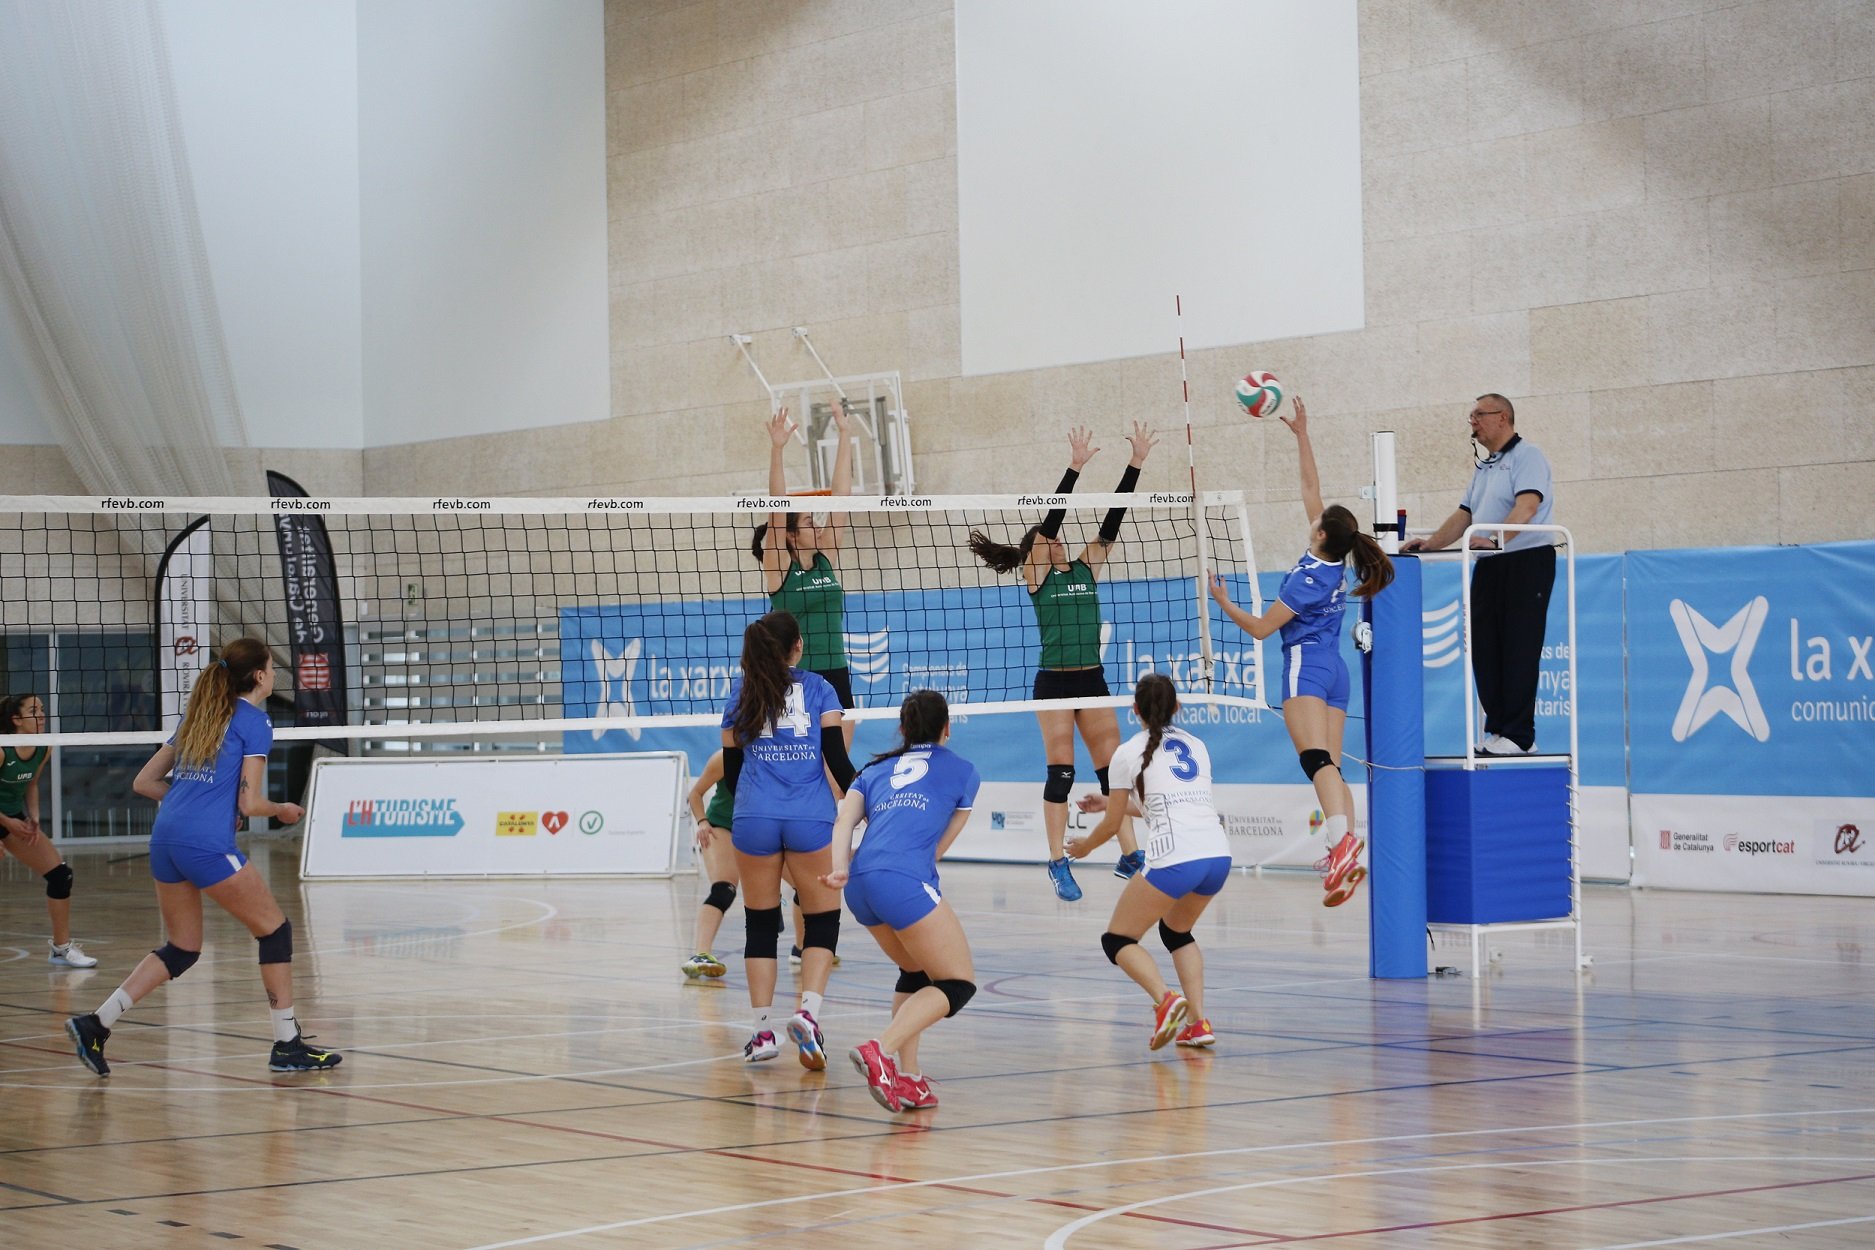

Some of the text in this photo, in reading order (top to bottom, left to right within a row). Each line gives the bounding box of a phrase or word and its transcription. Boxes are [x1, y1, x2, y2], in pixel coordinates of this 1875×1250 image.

[101, 498, 164, 509] rfevb.com
[270, 498, 331, 510] rfevb.com
[432, 498, 491, 510] rfevb.com
[587, 498, 644, 510] rfevb.com
[736, 497, 791, 508] rfevb.com
[880, 496, 932, 507] rfevb.com
[1017, 495, 1067, 506] rfevb.com
[1791, 618, 1832, 682] la
[1126, 639, 1155, 692] la
[651, 654, 673, 699] la
[1224, 704, 1262, 724] local
[753, 751, 816, 761] ARCELONA
[1163, 737, 1199, 782] 3
[890, 751, 933, 790] 5
[1227, 814, 1275, 825] UNIVERSITAT
[1228, 826, 1284, 836] BARCELONA
[1673, 832, 1708, 842] Generalitat
[1682, 843, 1714, 853] Catalunya
[1738, 839, 1795, 856] esportcat
